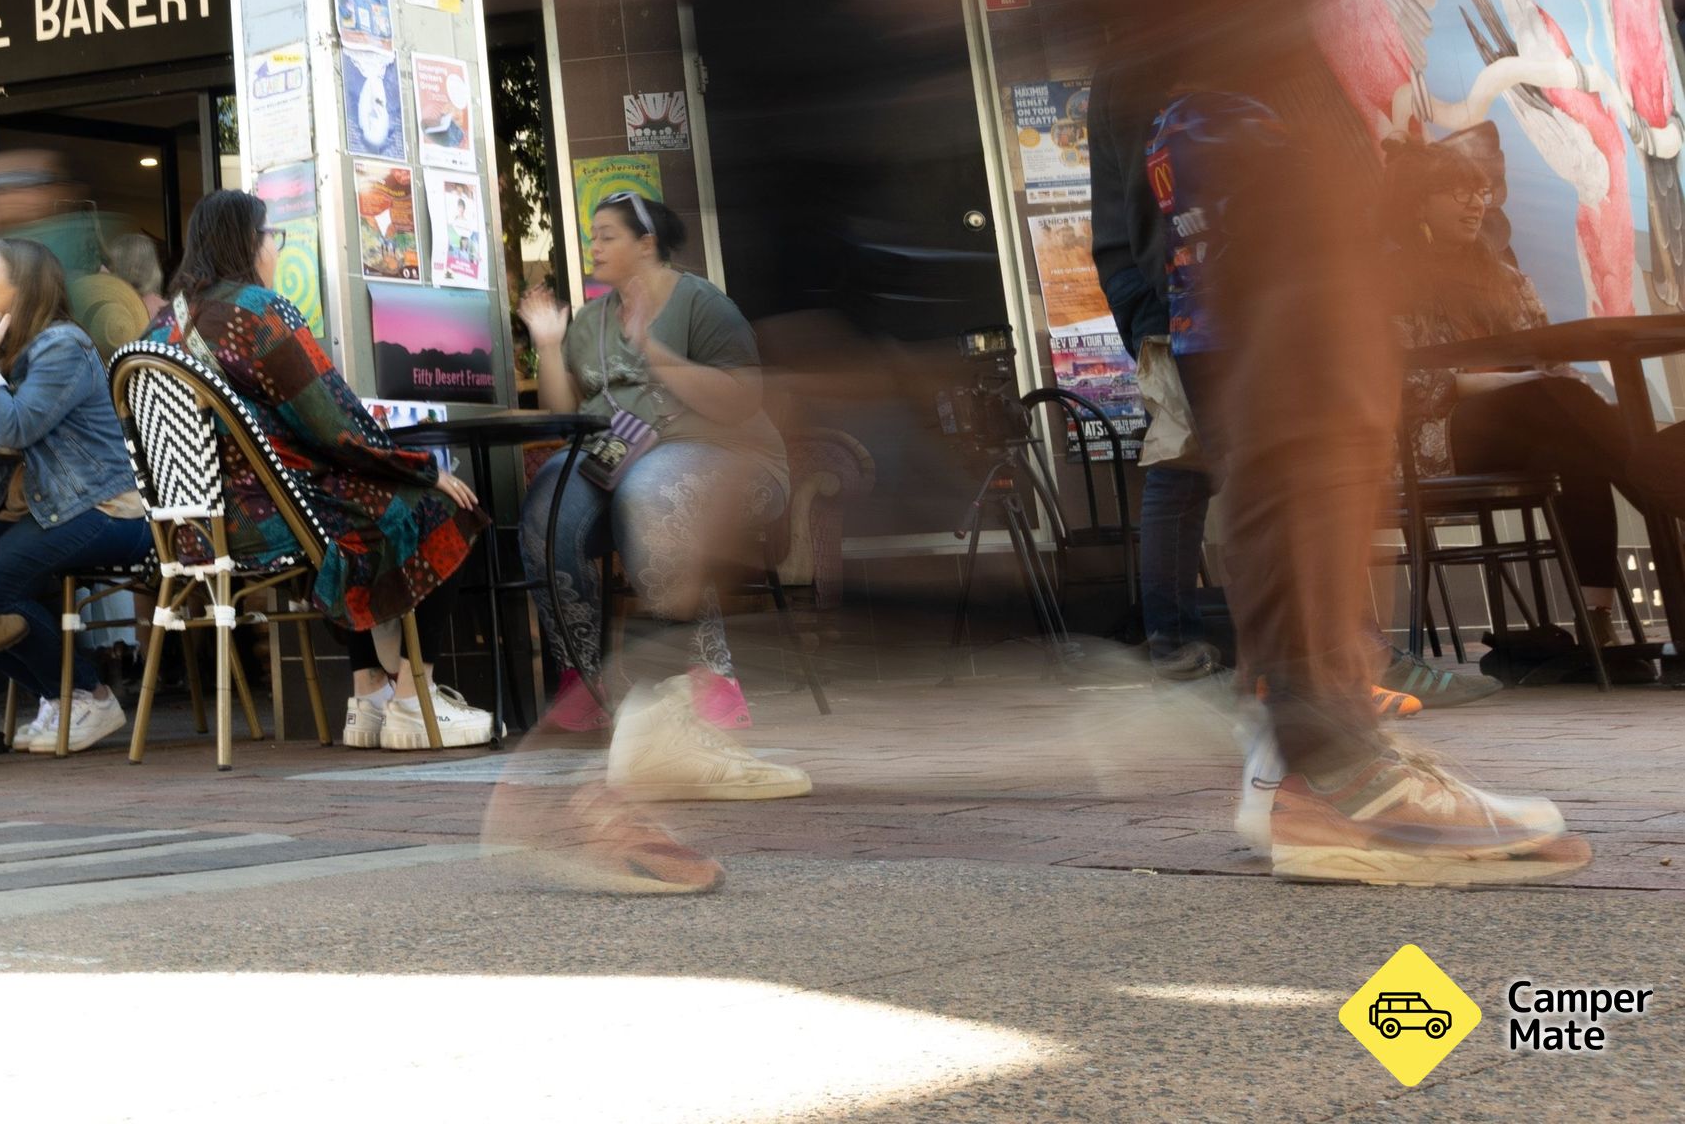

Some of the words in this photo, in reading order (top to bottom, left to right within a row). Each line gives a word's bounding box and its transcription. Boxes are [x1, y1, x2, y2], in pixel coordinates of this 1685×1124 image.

[1016, 98, 1048, 108] HENLEY
[1017, 109, 1031, 117] ON
[1032, 106, 1056, 116] TODD
[1018, 115, 1058, 126] REGATTA
[1068, 337, 1079, 348] UP
[1082, 335, 1102, 347] YOUR
[413, 367, 433, 387] Fifty
[435, 367, 465, 386] Desert
[466, 369, 496, 388] Frames
[1081, 420, 1104, 436] ATS
